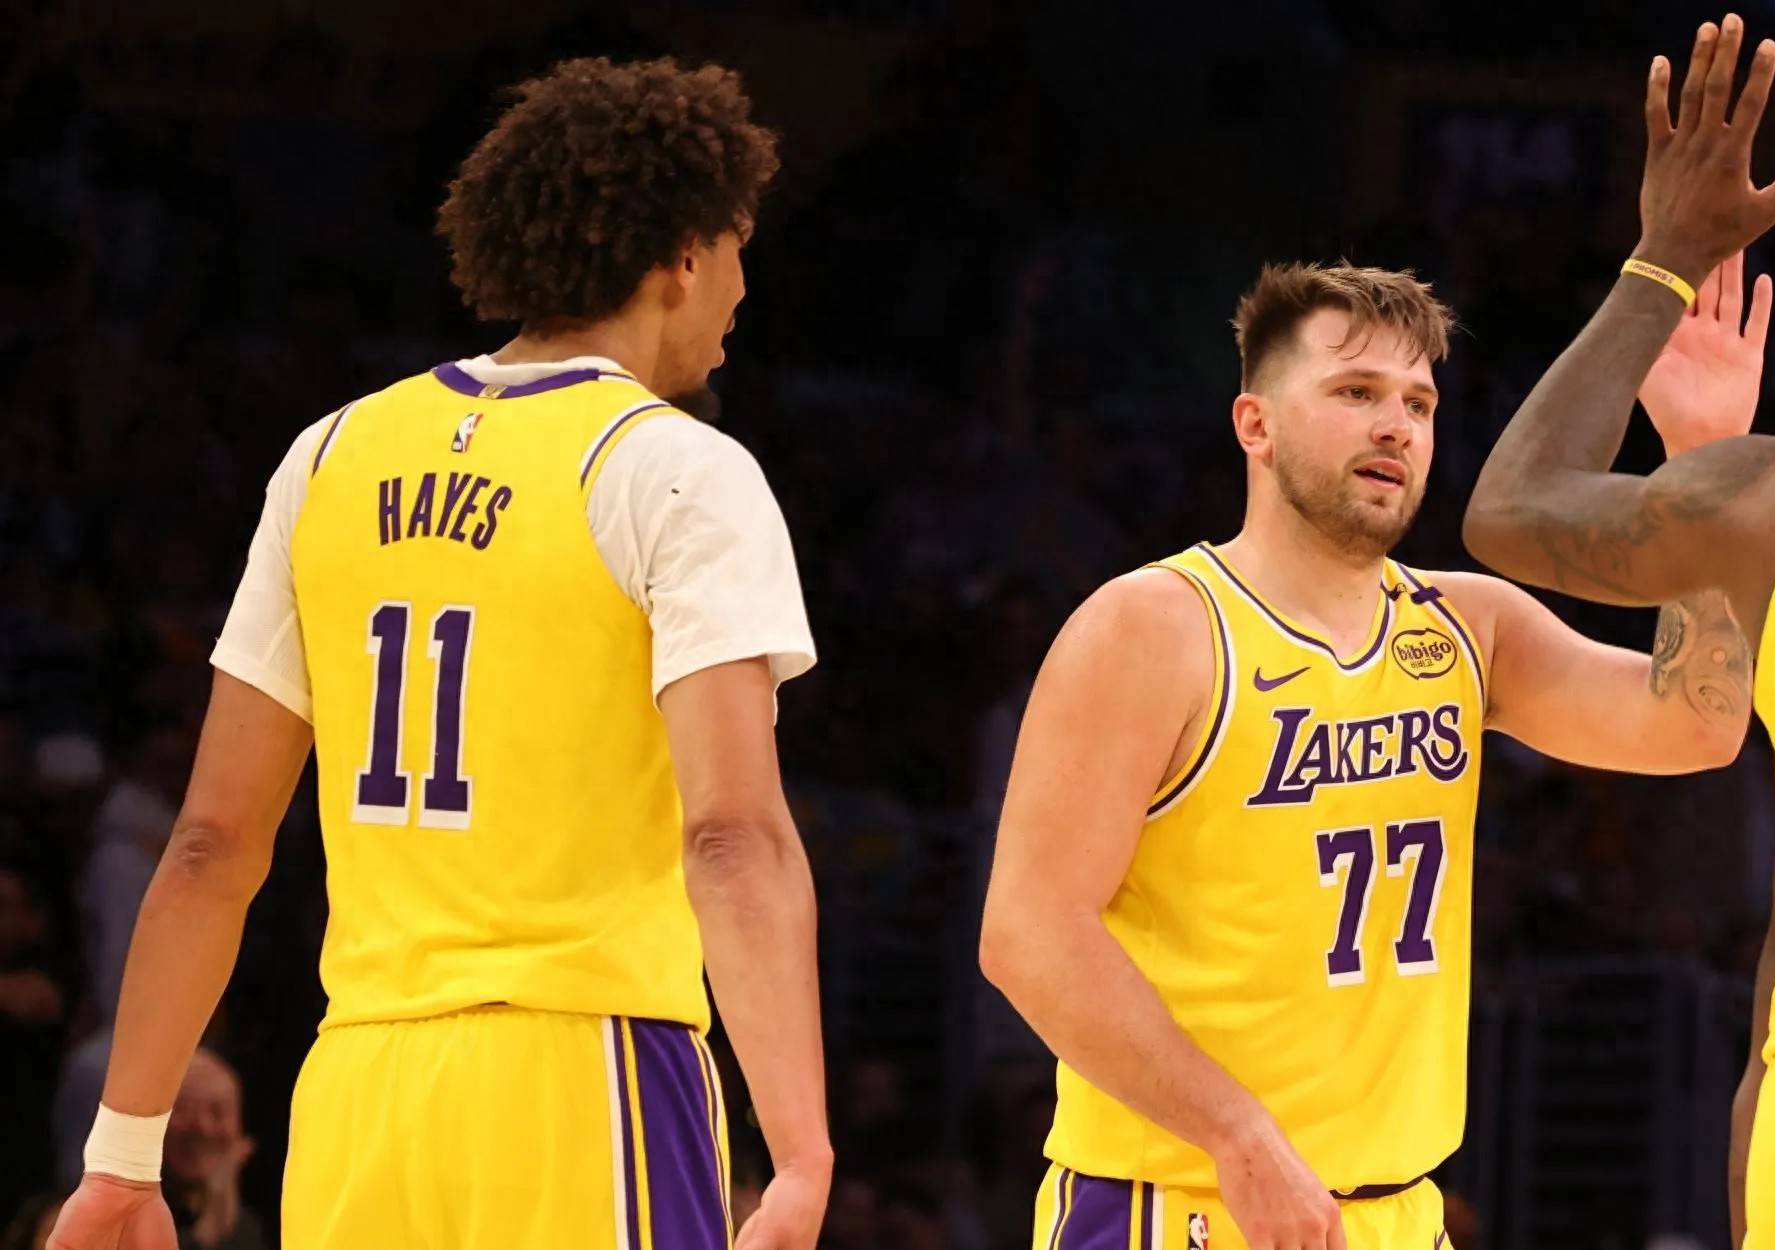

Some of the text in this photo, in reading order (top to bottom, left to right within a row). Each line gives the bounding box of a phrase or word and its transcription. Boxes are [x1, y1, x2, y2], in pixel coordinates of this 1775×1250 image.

[378, 471, 513, 551] HAYES
[1395, 640, 1452, 662] bibigo
[350, 598, 476, 831] 11
[1243, 703, 1470, 809] LAKERS
[1313, 816, 1447, 987] 77
